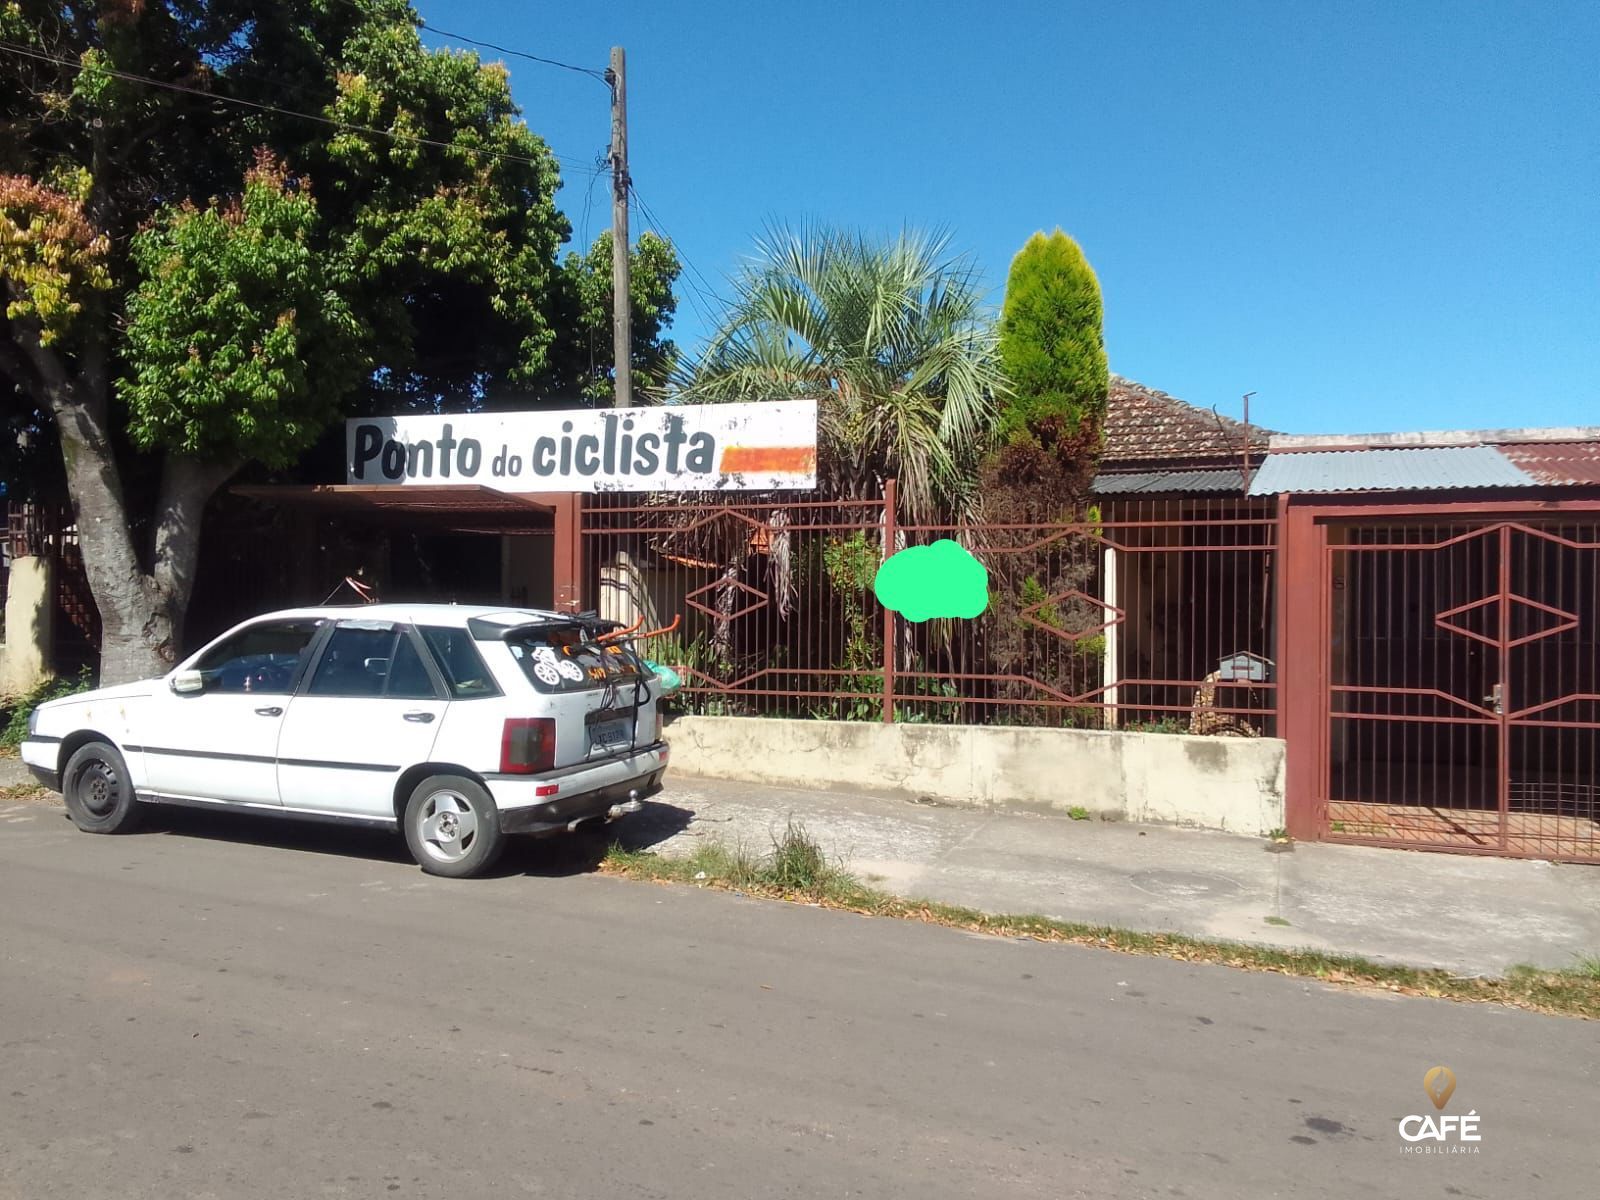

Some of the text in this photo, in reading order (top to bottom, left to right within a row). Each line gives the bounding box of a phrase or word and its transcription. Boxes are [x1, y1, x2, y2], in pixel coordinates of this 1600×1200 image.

[354, 414, 716, 480] Ponto do ciclista
